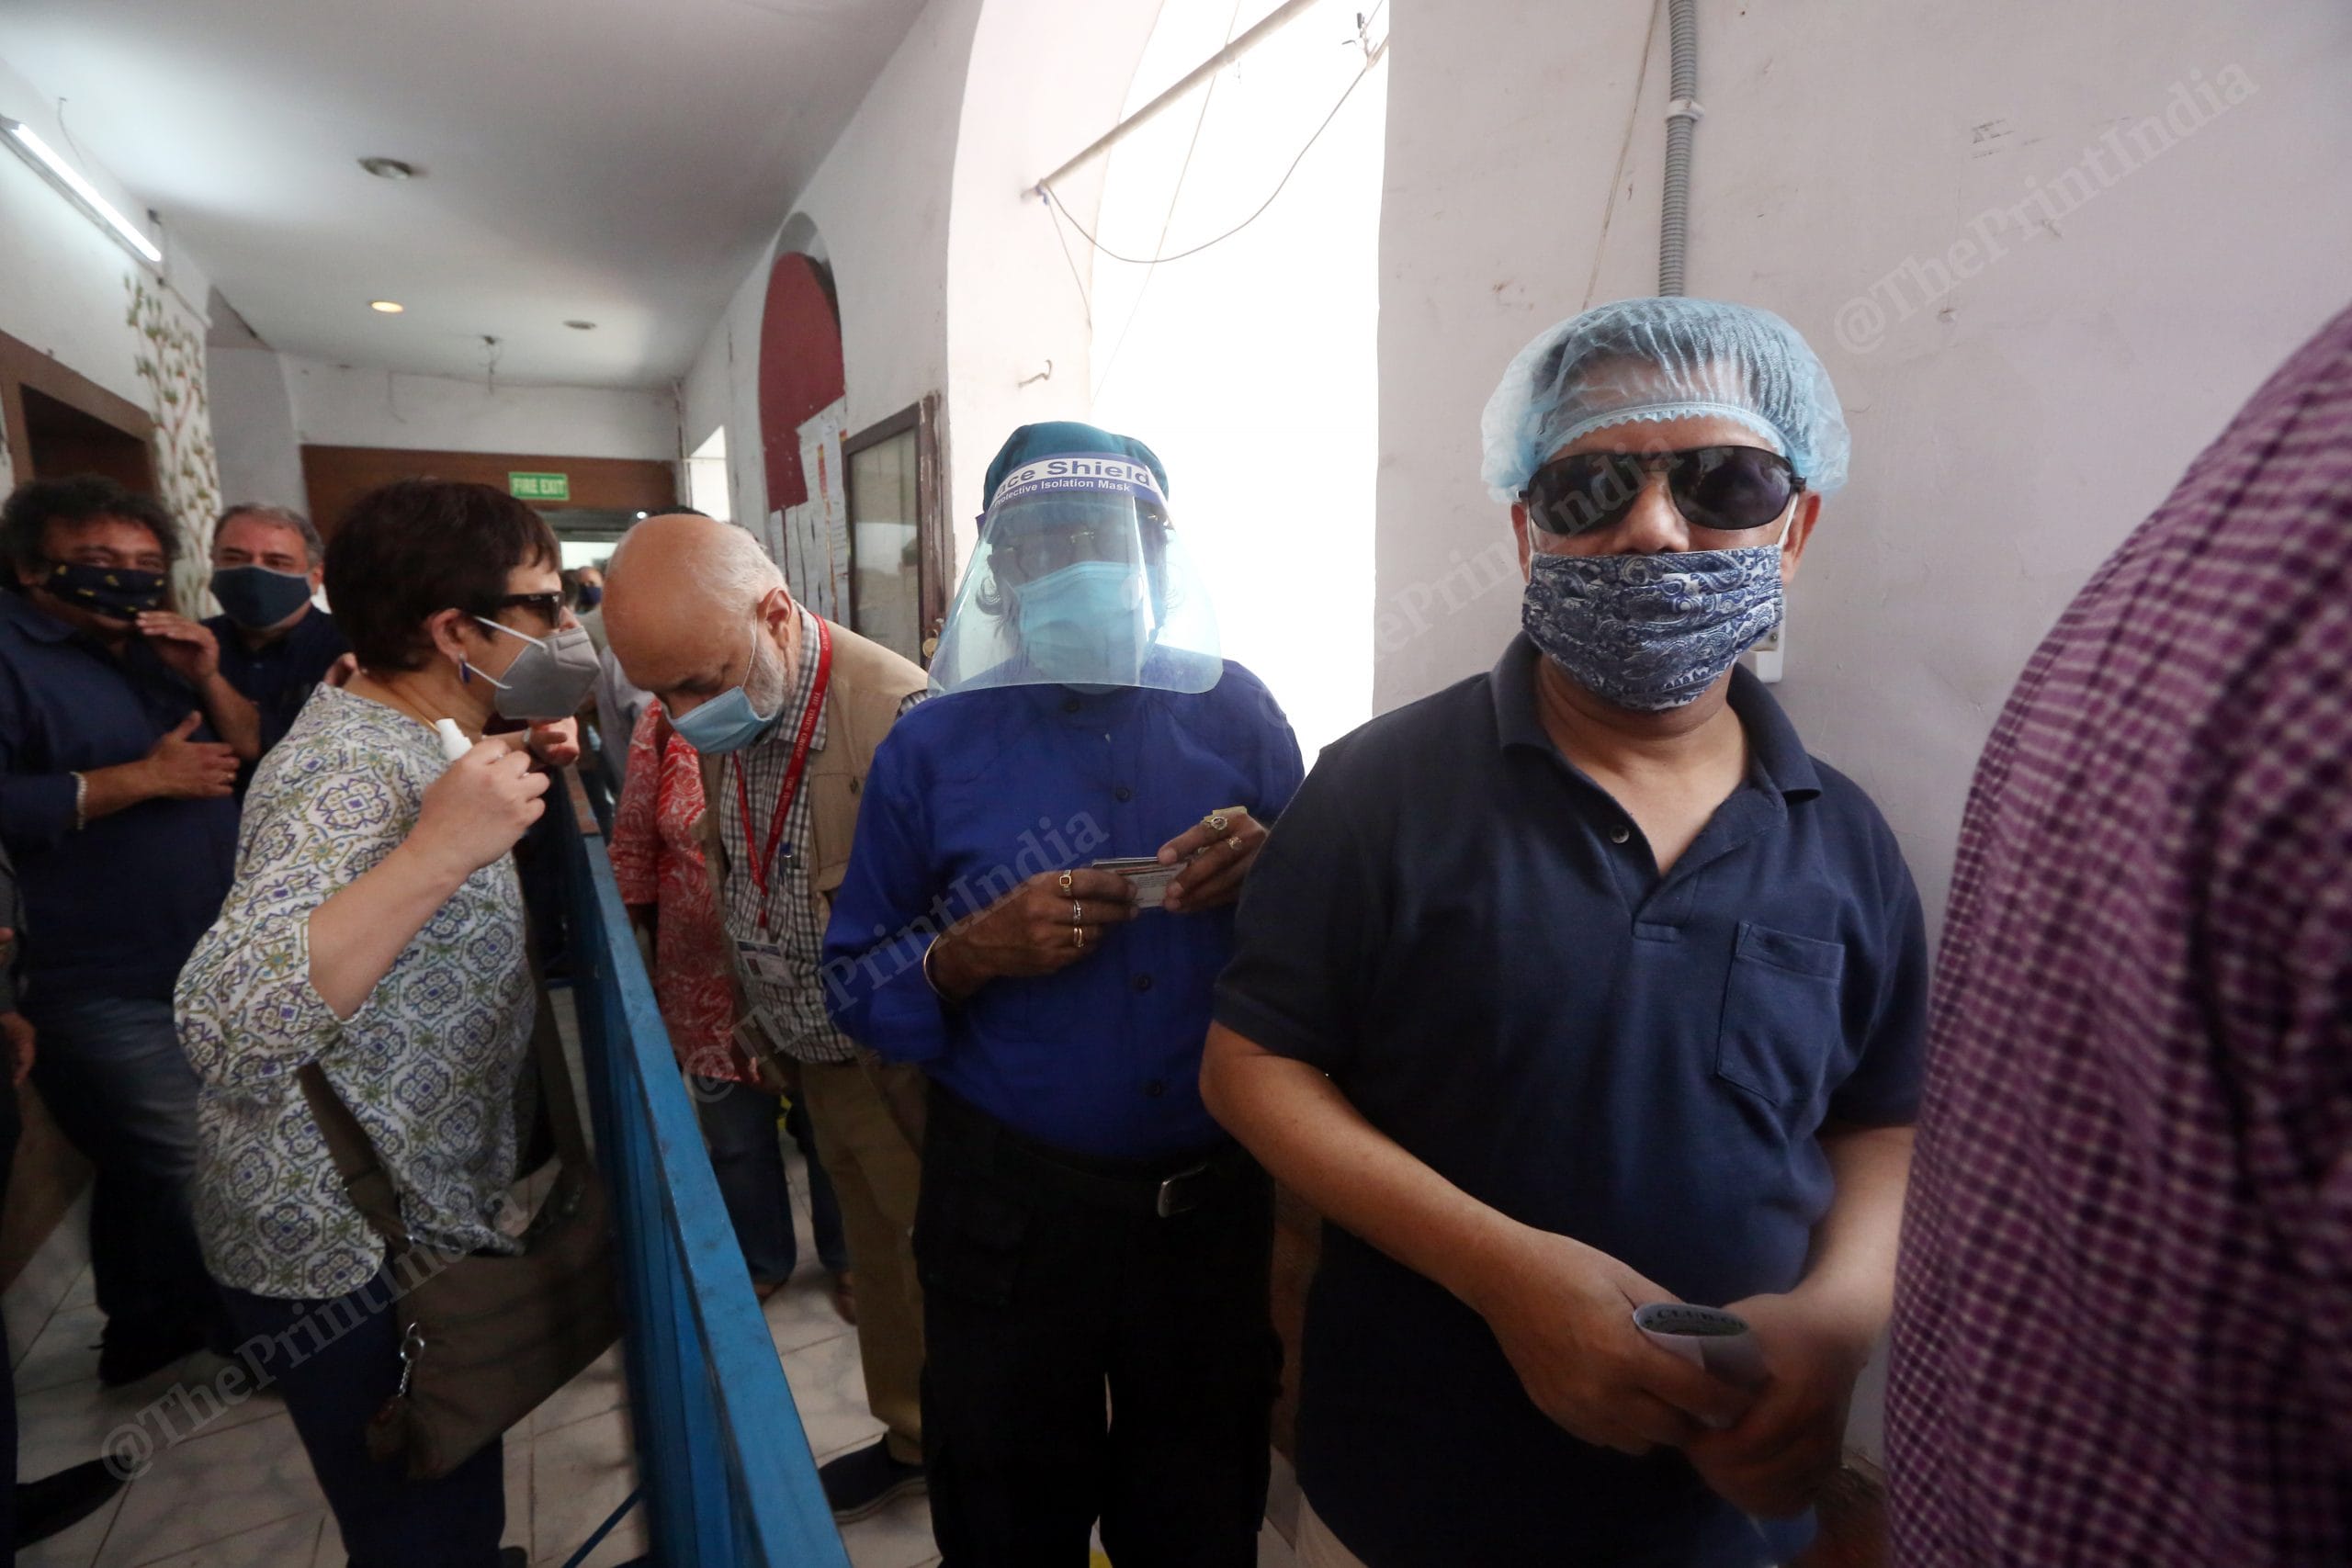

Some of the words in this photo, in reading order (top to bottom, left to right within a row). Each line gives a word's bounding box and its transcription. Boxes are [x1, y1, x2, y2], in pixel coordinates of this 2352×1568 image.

[1047, 460, 1150, 486] Shield
[539, 478, 567, 496] EXIT
[994, 484, 1038, 508] Protective
[1041, 479, 1094, 490] Isolation
[1098, 479, 1131, 492] Mask
